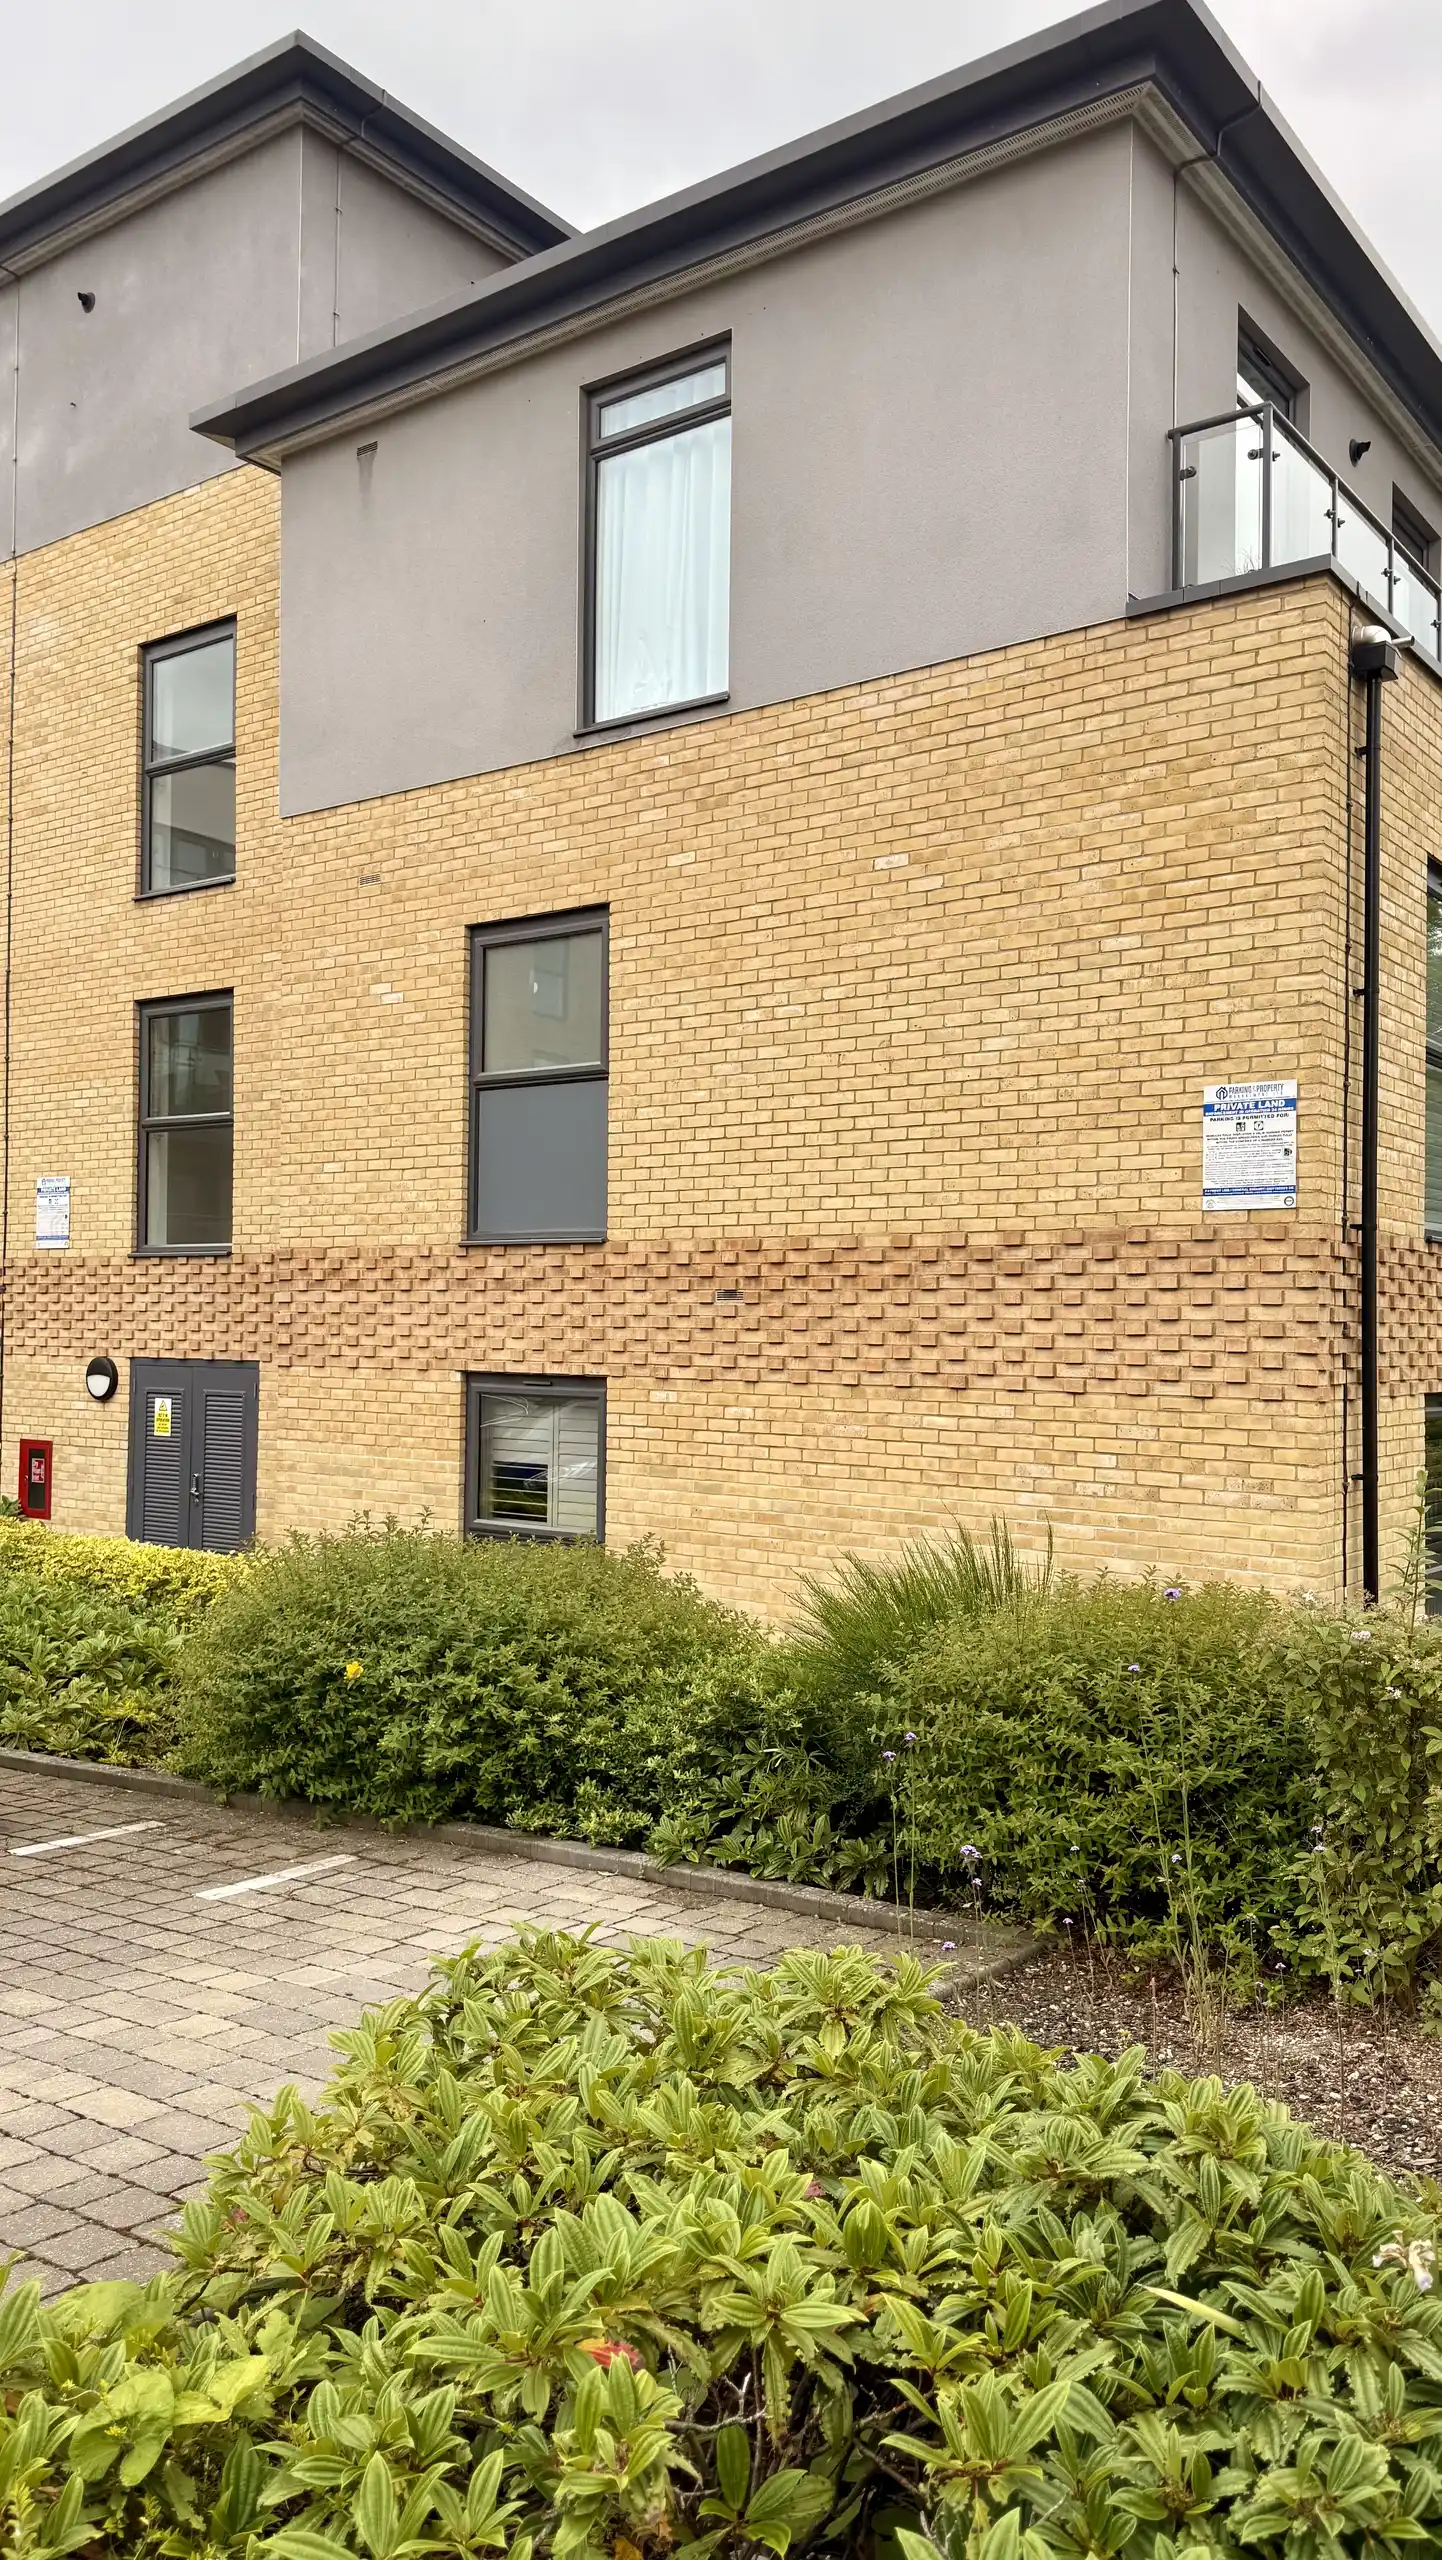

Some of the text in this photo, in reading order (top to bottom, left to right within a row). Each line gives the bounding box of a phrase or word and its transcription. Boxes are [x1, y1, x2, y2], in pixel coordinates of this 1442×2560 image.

[1229, 1085, 1252, 1094] PARKING
[1256, 1084, 1284, 1092] PROPERTY
[1214, 1102, 1256, 1112] PRIVATE
[1258, 1100, 1285, 1108] LAND
